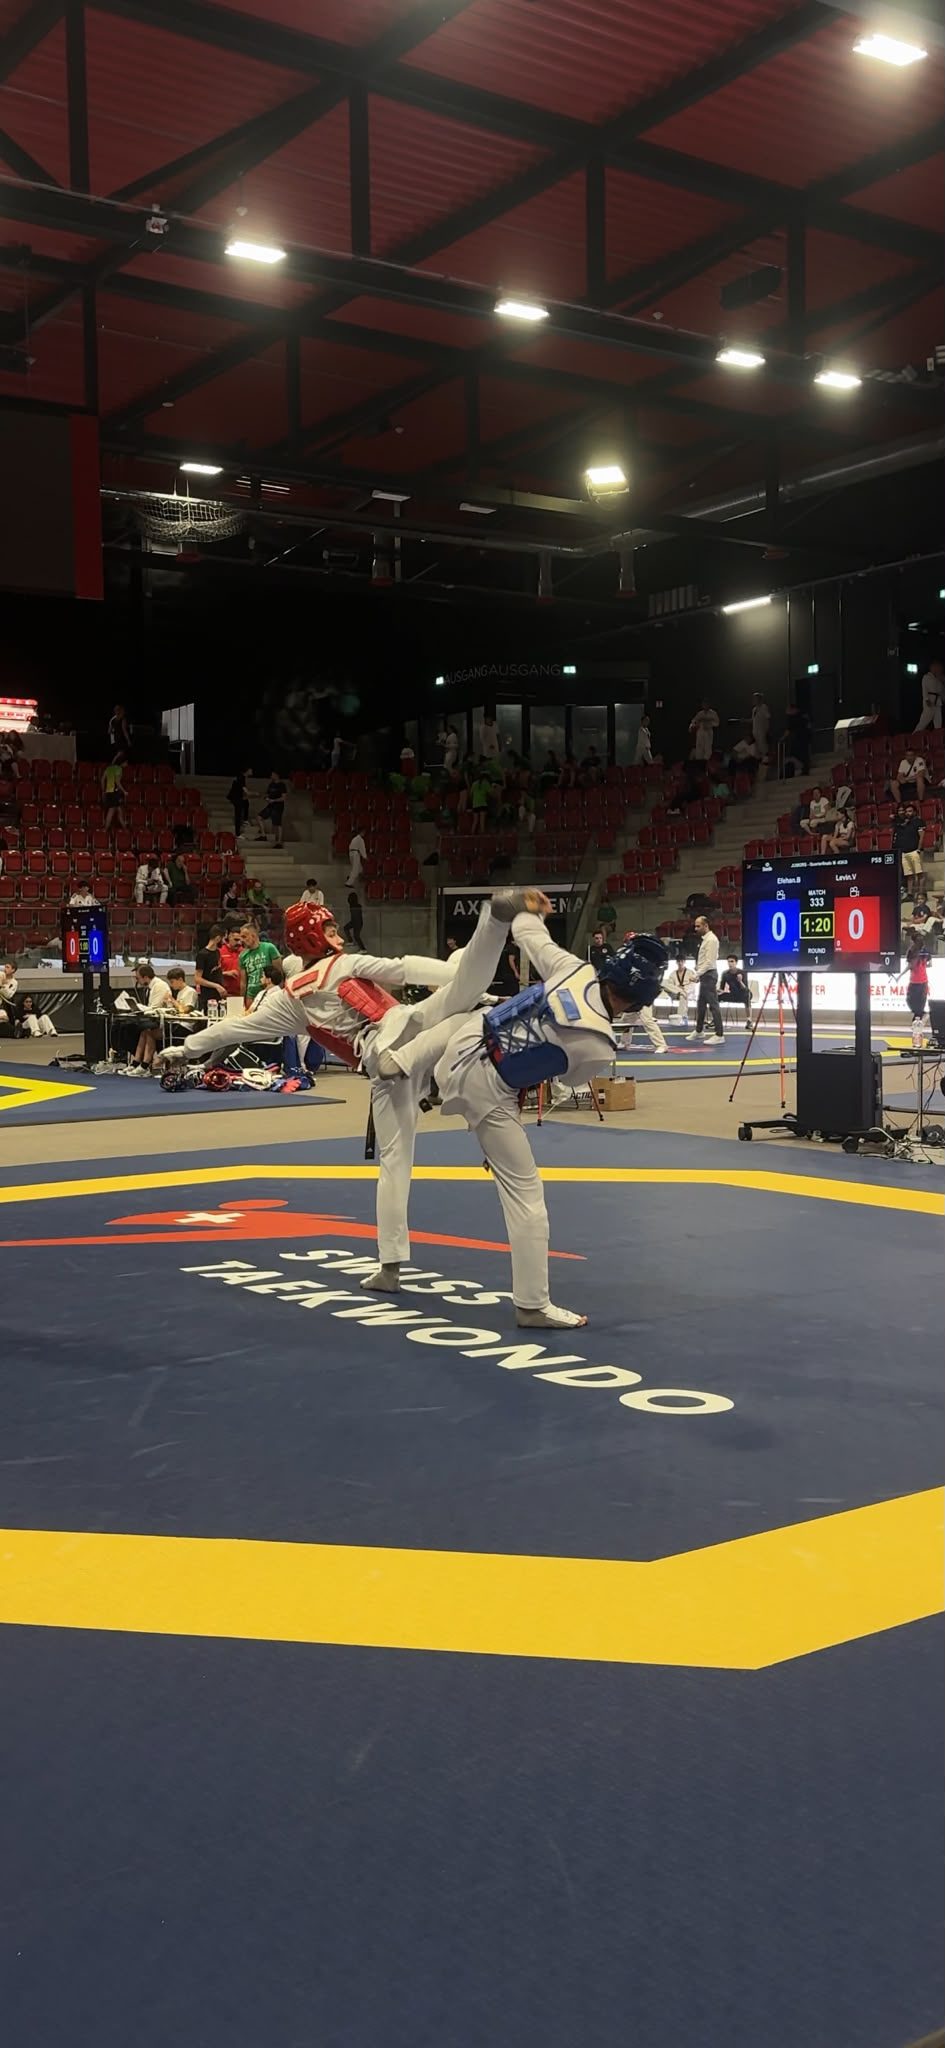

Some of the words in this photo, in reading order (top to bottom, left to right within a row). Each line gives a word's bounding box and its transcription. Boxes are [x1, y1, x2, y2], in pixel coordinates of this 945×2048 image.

[445, 665, 488, 685] AUSGANG
[488, 664, 561, 677] AUSGANG
[809, 897, 825, 907] 333
[771, 911, 787, 941] 0
[803, 917, 831, 933] 1:20
[848, 908, 865, 940] 0
[70, 938, 75, 955] 0
[93, 937, 98, 955] 0
[278, 1248, 513, 1306] SWISS
[179, 1259, 735, 1415] TAEKWONDO
